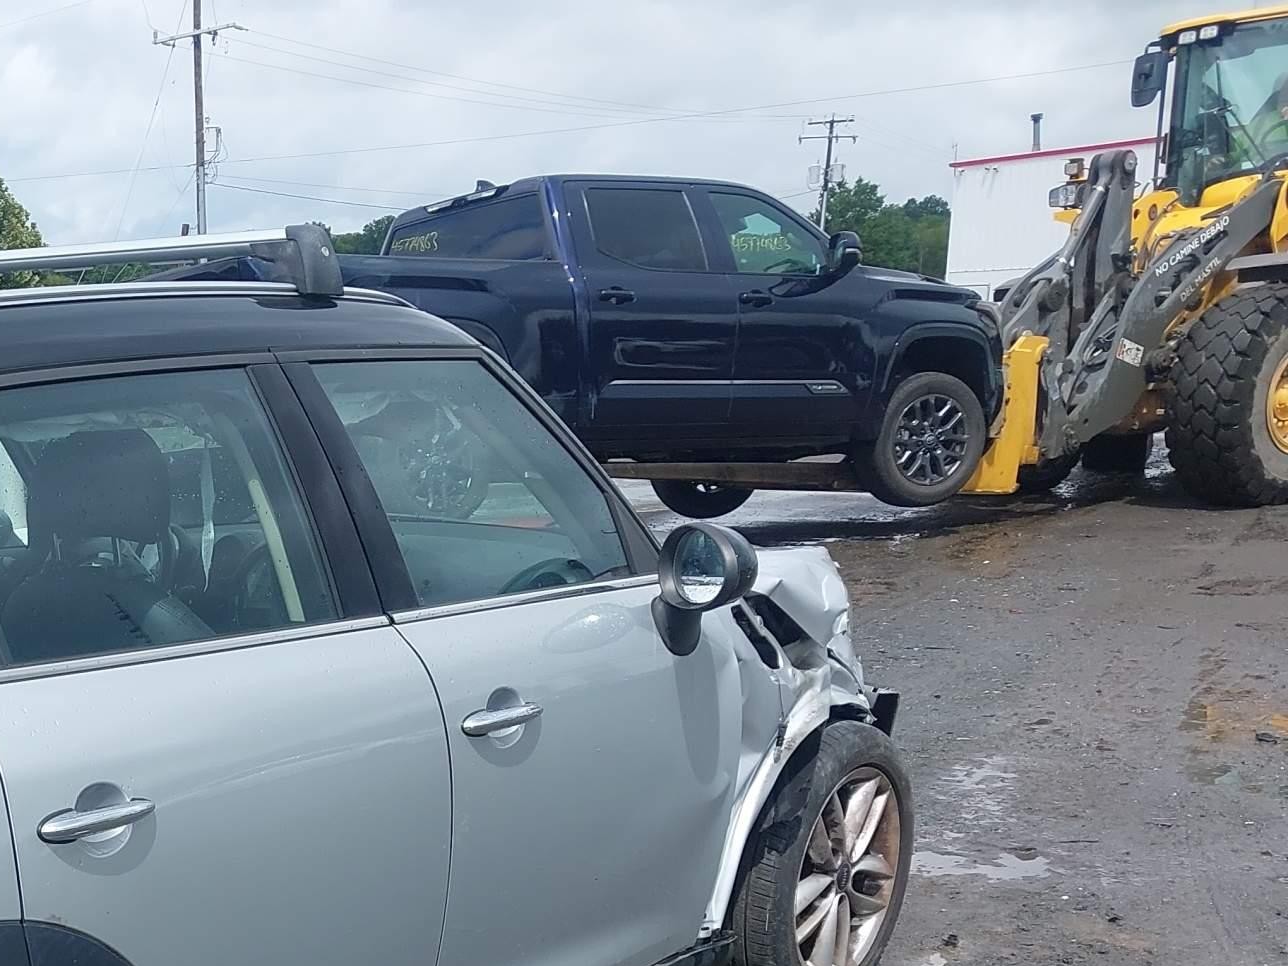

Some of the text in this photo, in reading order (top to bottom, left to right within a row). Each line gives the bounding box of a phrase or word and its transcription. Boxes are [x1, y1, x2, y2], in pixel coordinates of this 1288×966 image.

[1155, 216, 1230, 277] NO CAMINE DEBAJO
[1180, 256, 1221, 302] DEL MASTIL
